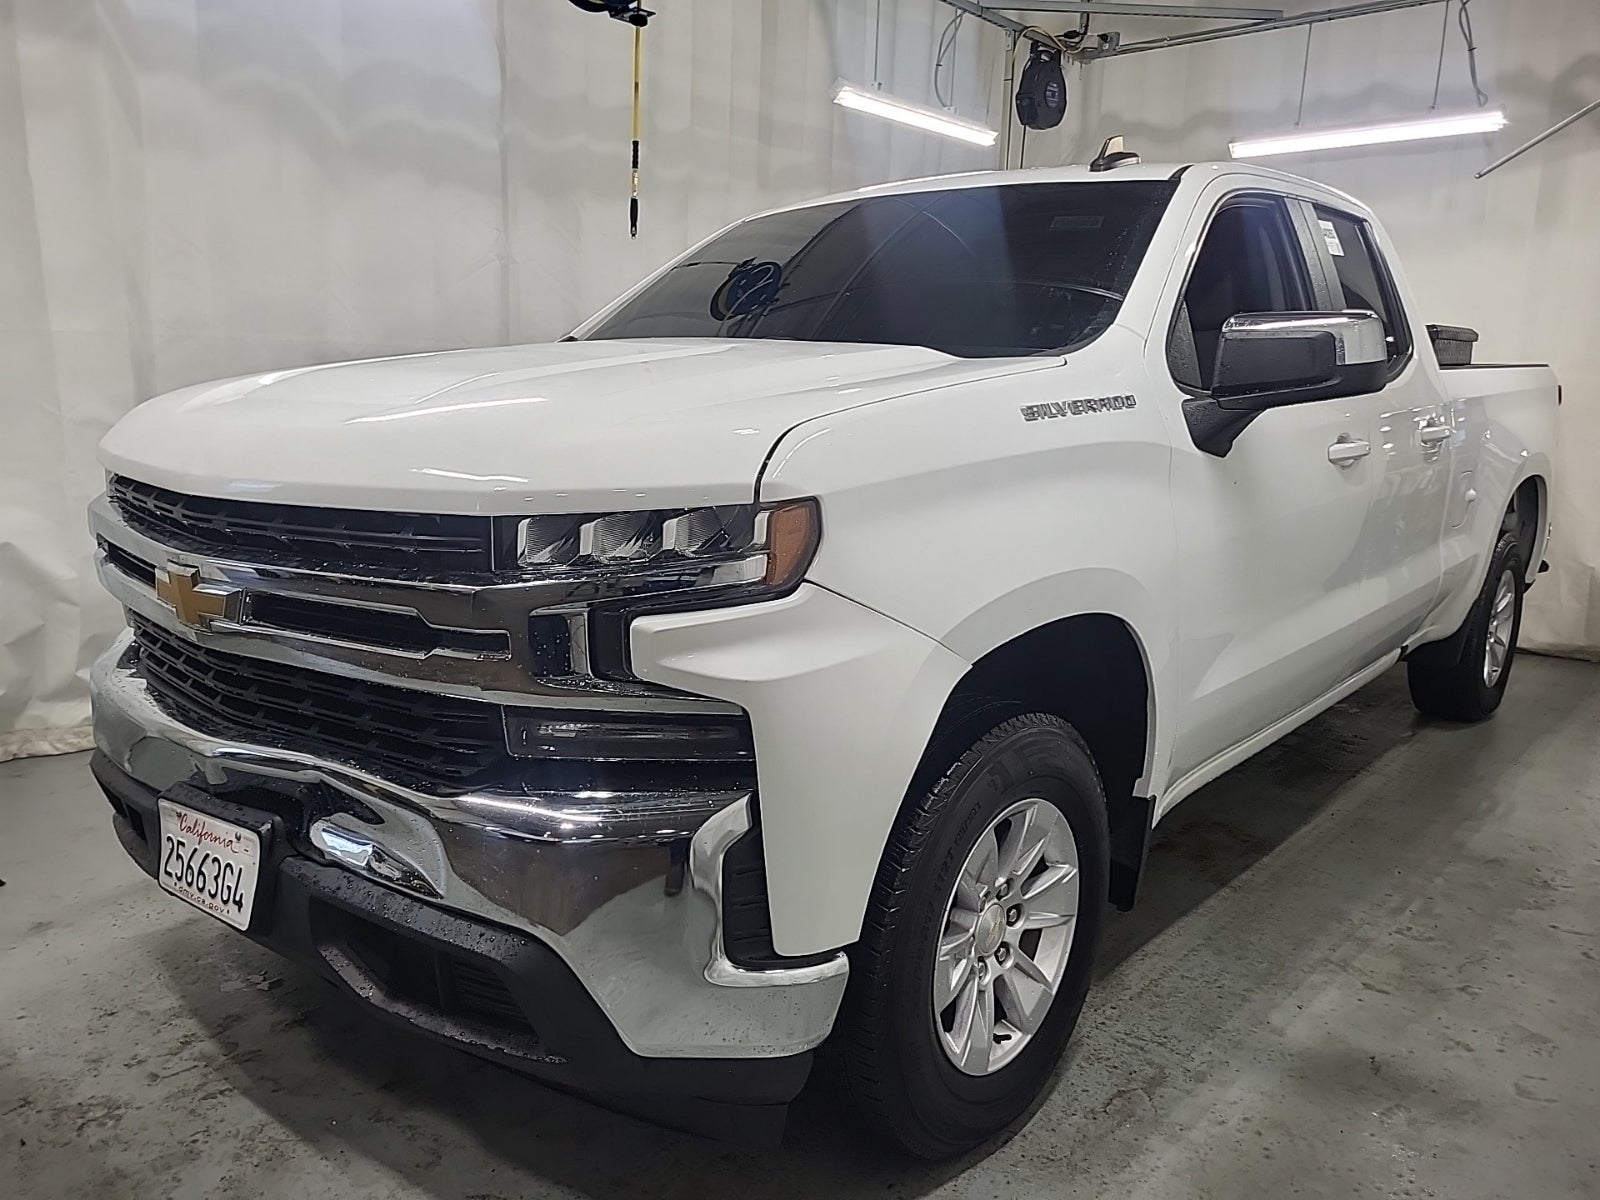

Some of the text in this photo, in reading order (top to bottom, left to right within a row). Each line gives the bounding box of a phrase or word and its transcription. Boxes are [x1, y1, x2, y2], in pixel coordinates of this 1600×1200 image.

[1020, 395, 1137, 421] SILVERADO
[179, 813, 240, 853] California
[164, 835, 244, 912] 25663G4
